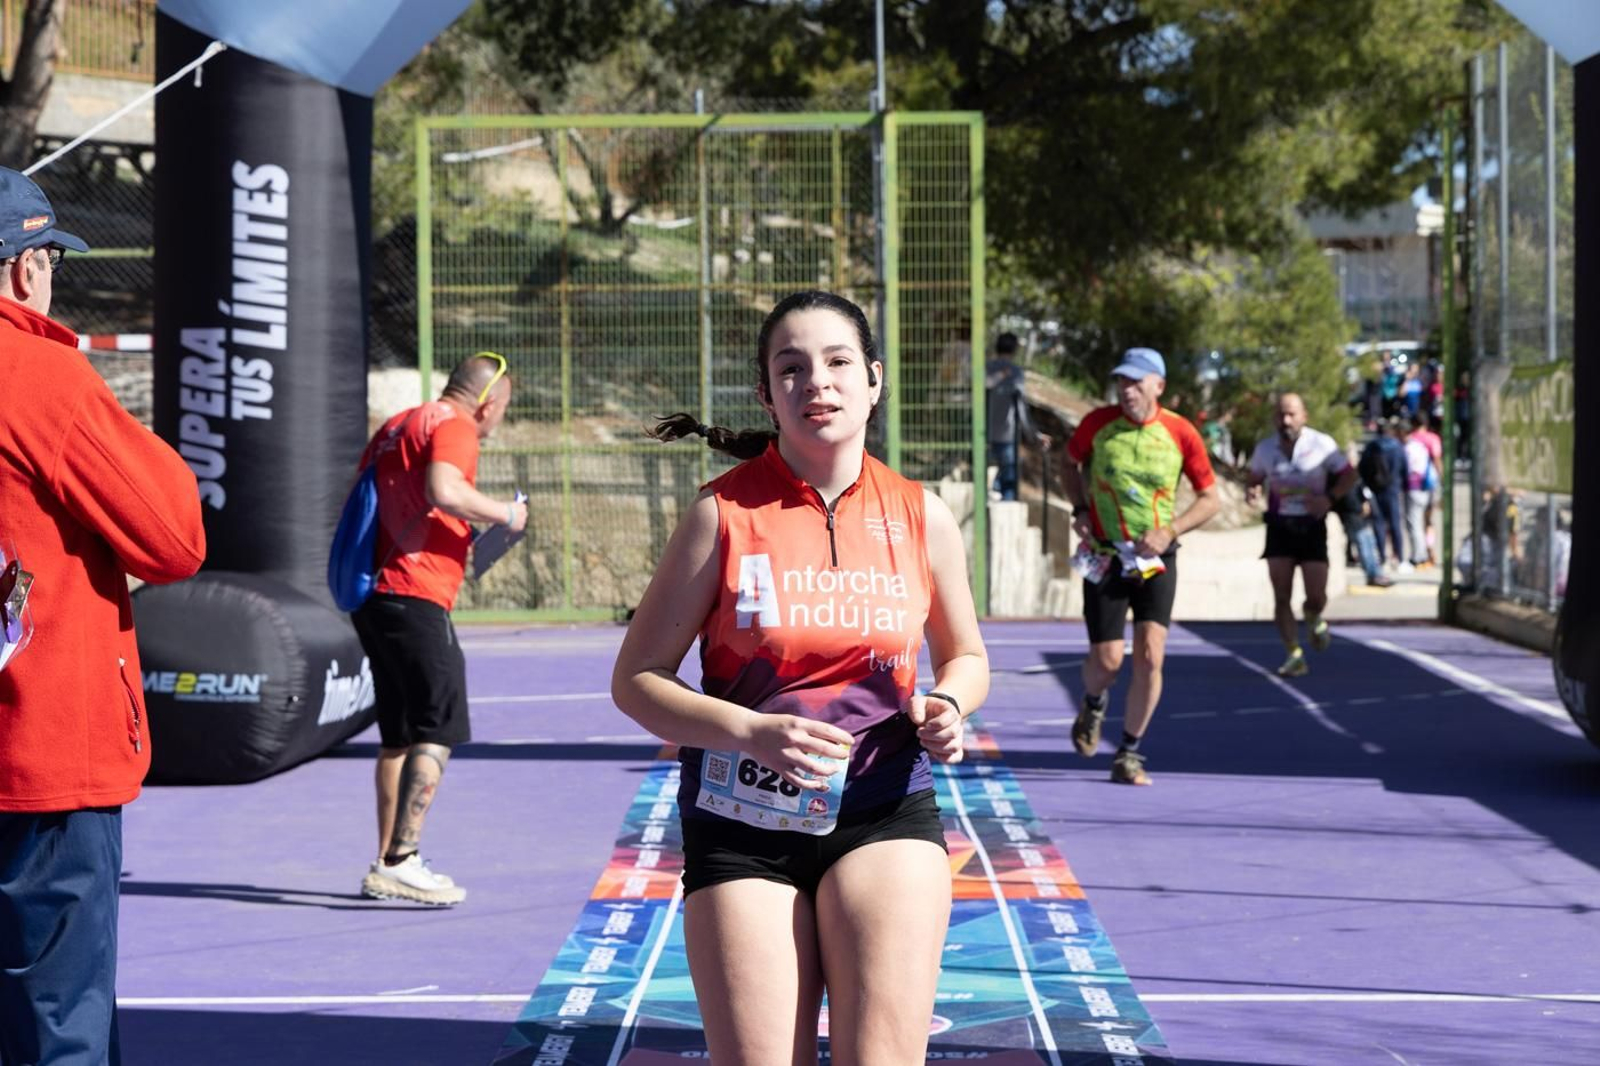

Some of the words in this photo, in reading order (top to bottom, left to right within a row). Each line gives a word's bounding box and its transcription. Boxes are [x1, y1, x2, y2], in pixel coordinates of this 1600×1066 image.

[217, 160, 290, 350] LÍMITES
[179, 327, 227, 511] SUPERA
[230, 355, 274, 420] TUS
[142, 671, 260, 695] ME2RUN
[861, 637, 914, 673] trail
